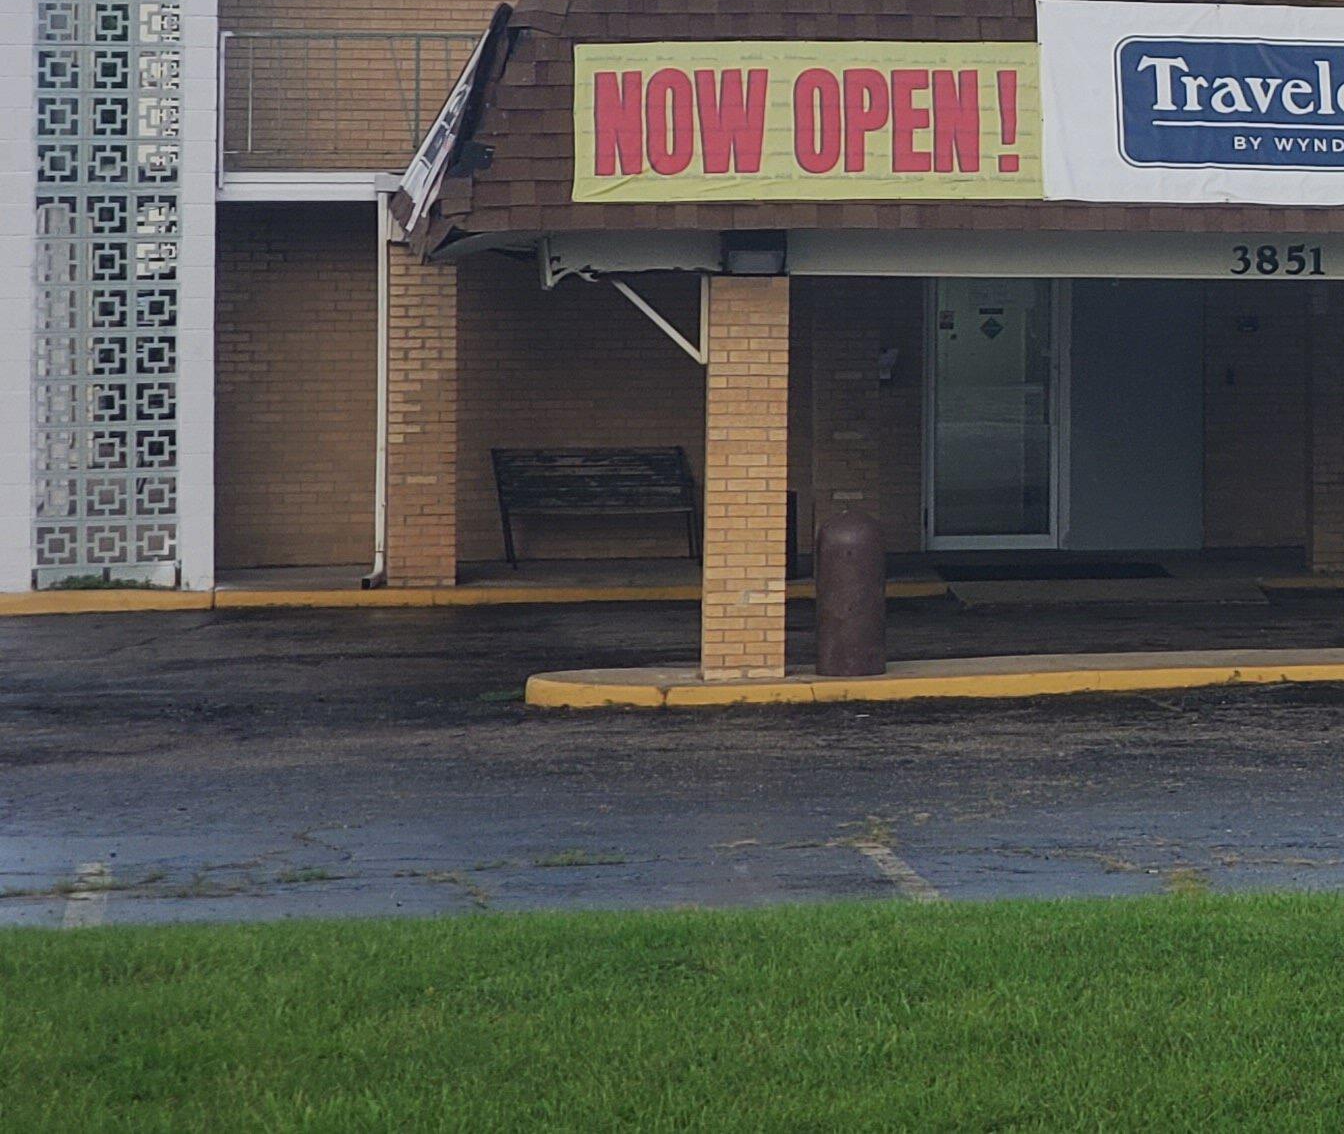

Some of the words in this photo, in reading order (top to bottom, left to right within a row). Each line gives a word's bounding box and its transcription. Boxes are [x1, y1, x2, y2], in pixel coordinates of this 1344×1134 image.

[593, 67, 769, 177] NOW
[1233, 136, 1263, 151] BY
[1230, 243, 1326, 276] 3851
